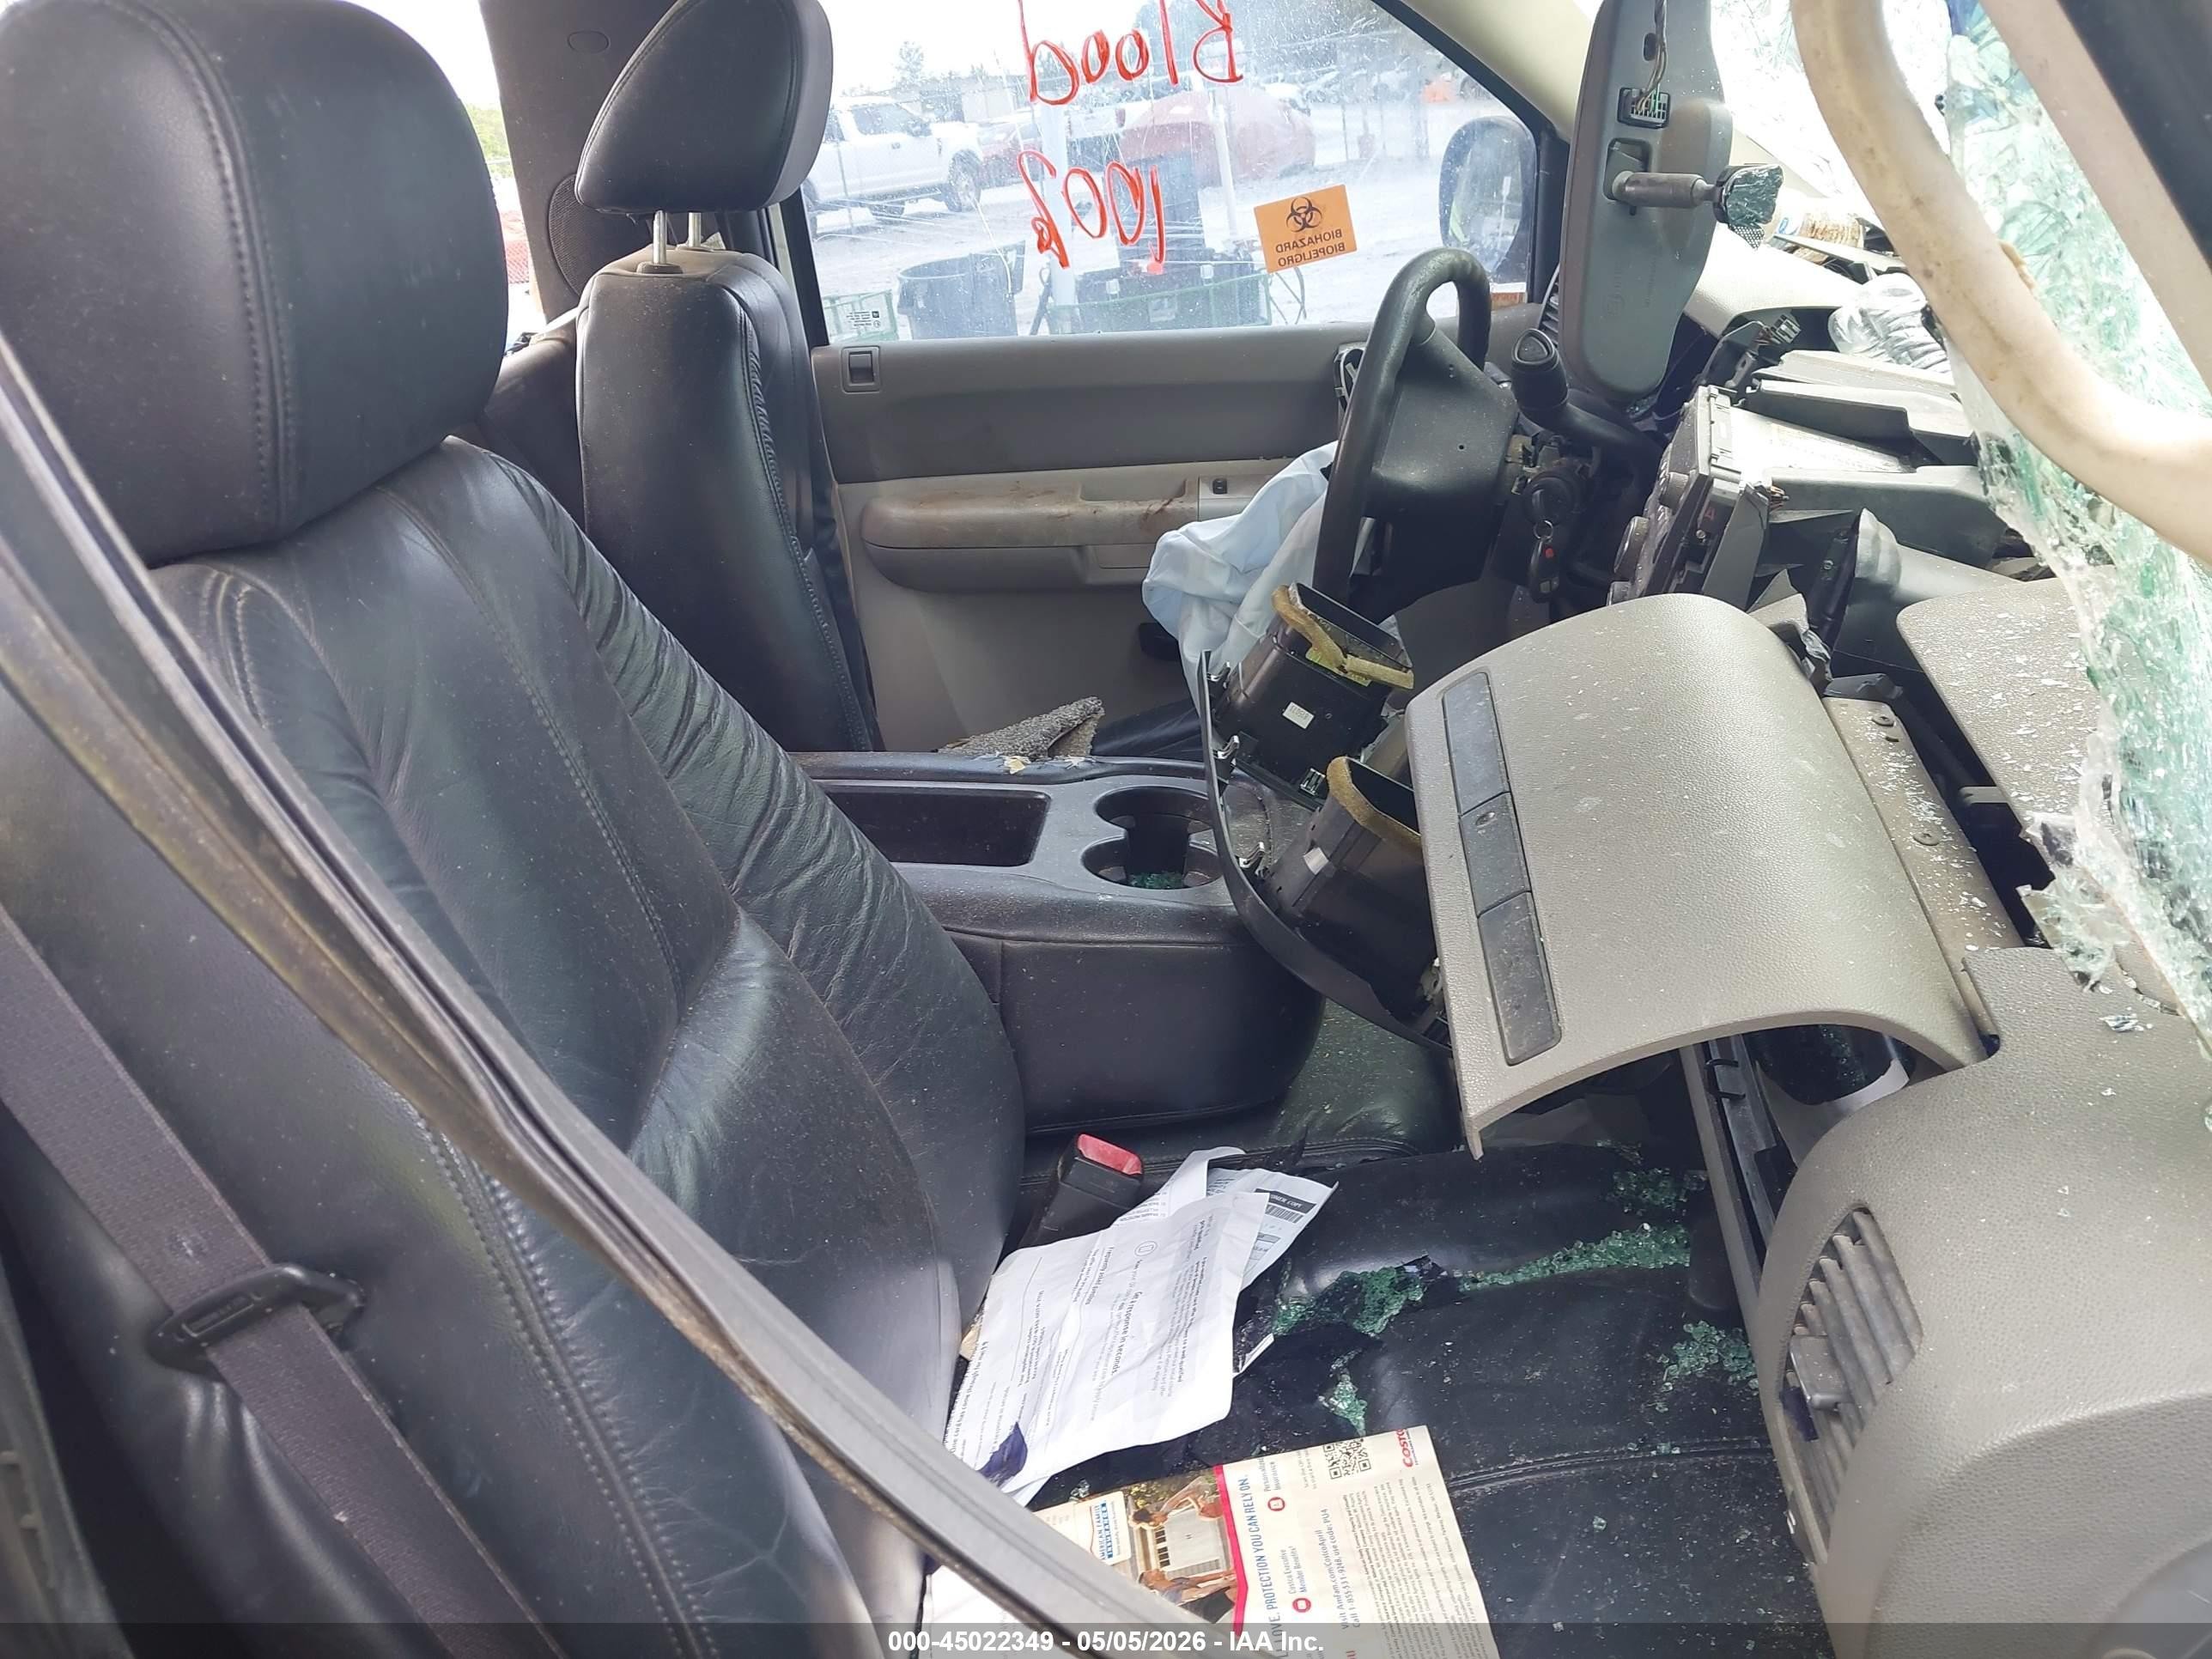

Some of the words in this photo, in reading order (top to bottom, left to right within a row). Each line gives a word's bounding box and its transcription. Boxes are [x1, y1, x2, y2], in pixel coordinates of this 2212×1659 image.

[1119, 1303, 1133, 1334] response
[1110, 1343, 1125, 1376] seconds.
[1241, 1492, 1256, 1515] RELY
[1245, 1516, 1260, 1533] CAN
[1321, 1509, 1330, 1523] PU4
[1097, 1530, 1106, 1559] AMERICAN
[1250, 1534, 1264, 1553] YOU
[1326, 1524, 1337, 1544] code:
[1315, 1529, 1344, 1610] AmFam.com/CostcoApril
[1255, 1555, 1278, 1610] PROTECTION
[1340, 1612, 1349, 1630] Visit
[1349, 1613, 1360, 1627] Call
